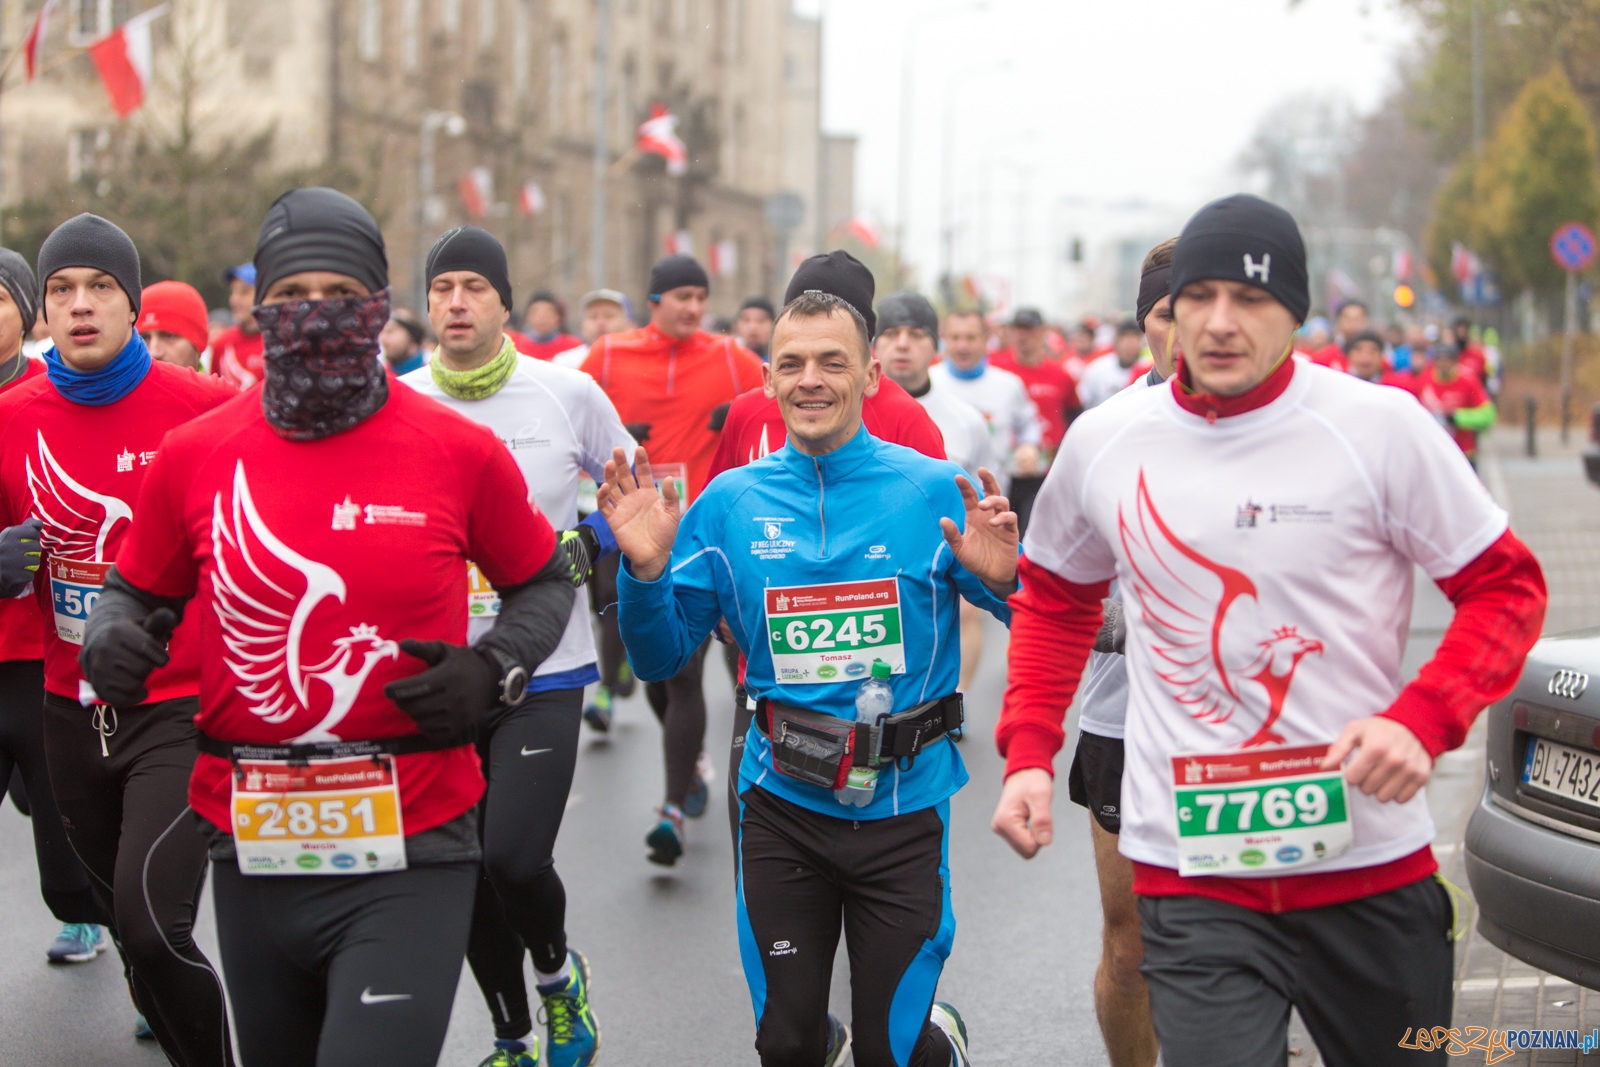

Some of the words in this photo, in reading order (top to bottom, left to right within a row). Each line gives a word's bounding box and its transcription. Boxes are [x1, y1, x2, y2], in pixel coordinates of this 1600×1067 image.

[54, 592, 61, 603] E
[834, 591, 889, 603] RunPoland.org
[785, 613, 887, 651] 6245
[820, 654, 852, 662] Tomasz
[1532, 743, 1551, 786] DL
[315, 770, 383, 784] RunPoland.org
[1195, 783, 1329, 832] 7769
[237, 813, 250, 826] D
[254, 796, 376, 837] 2851
[301, 842, 337, 850] Marcin
[1244, 835, 1282, 845] Marcin
